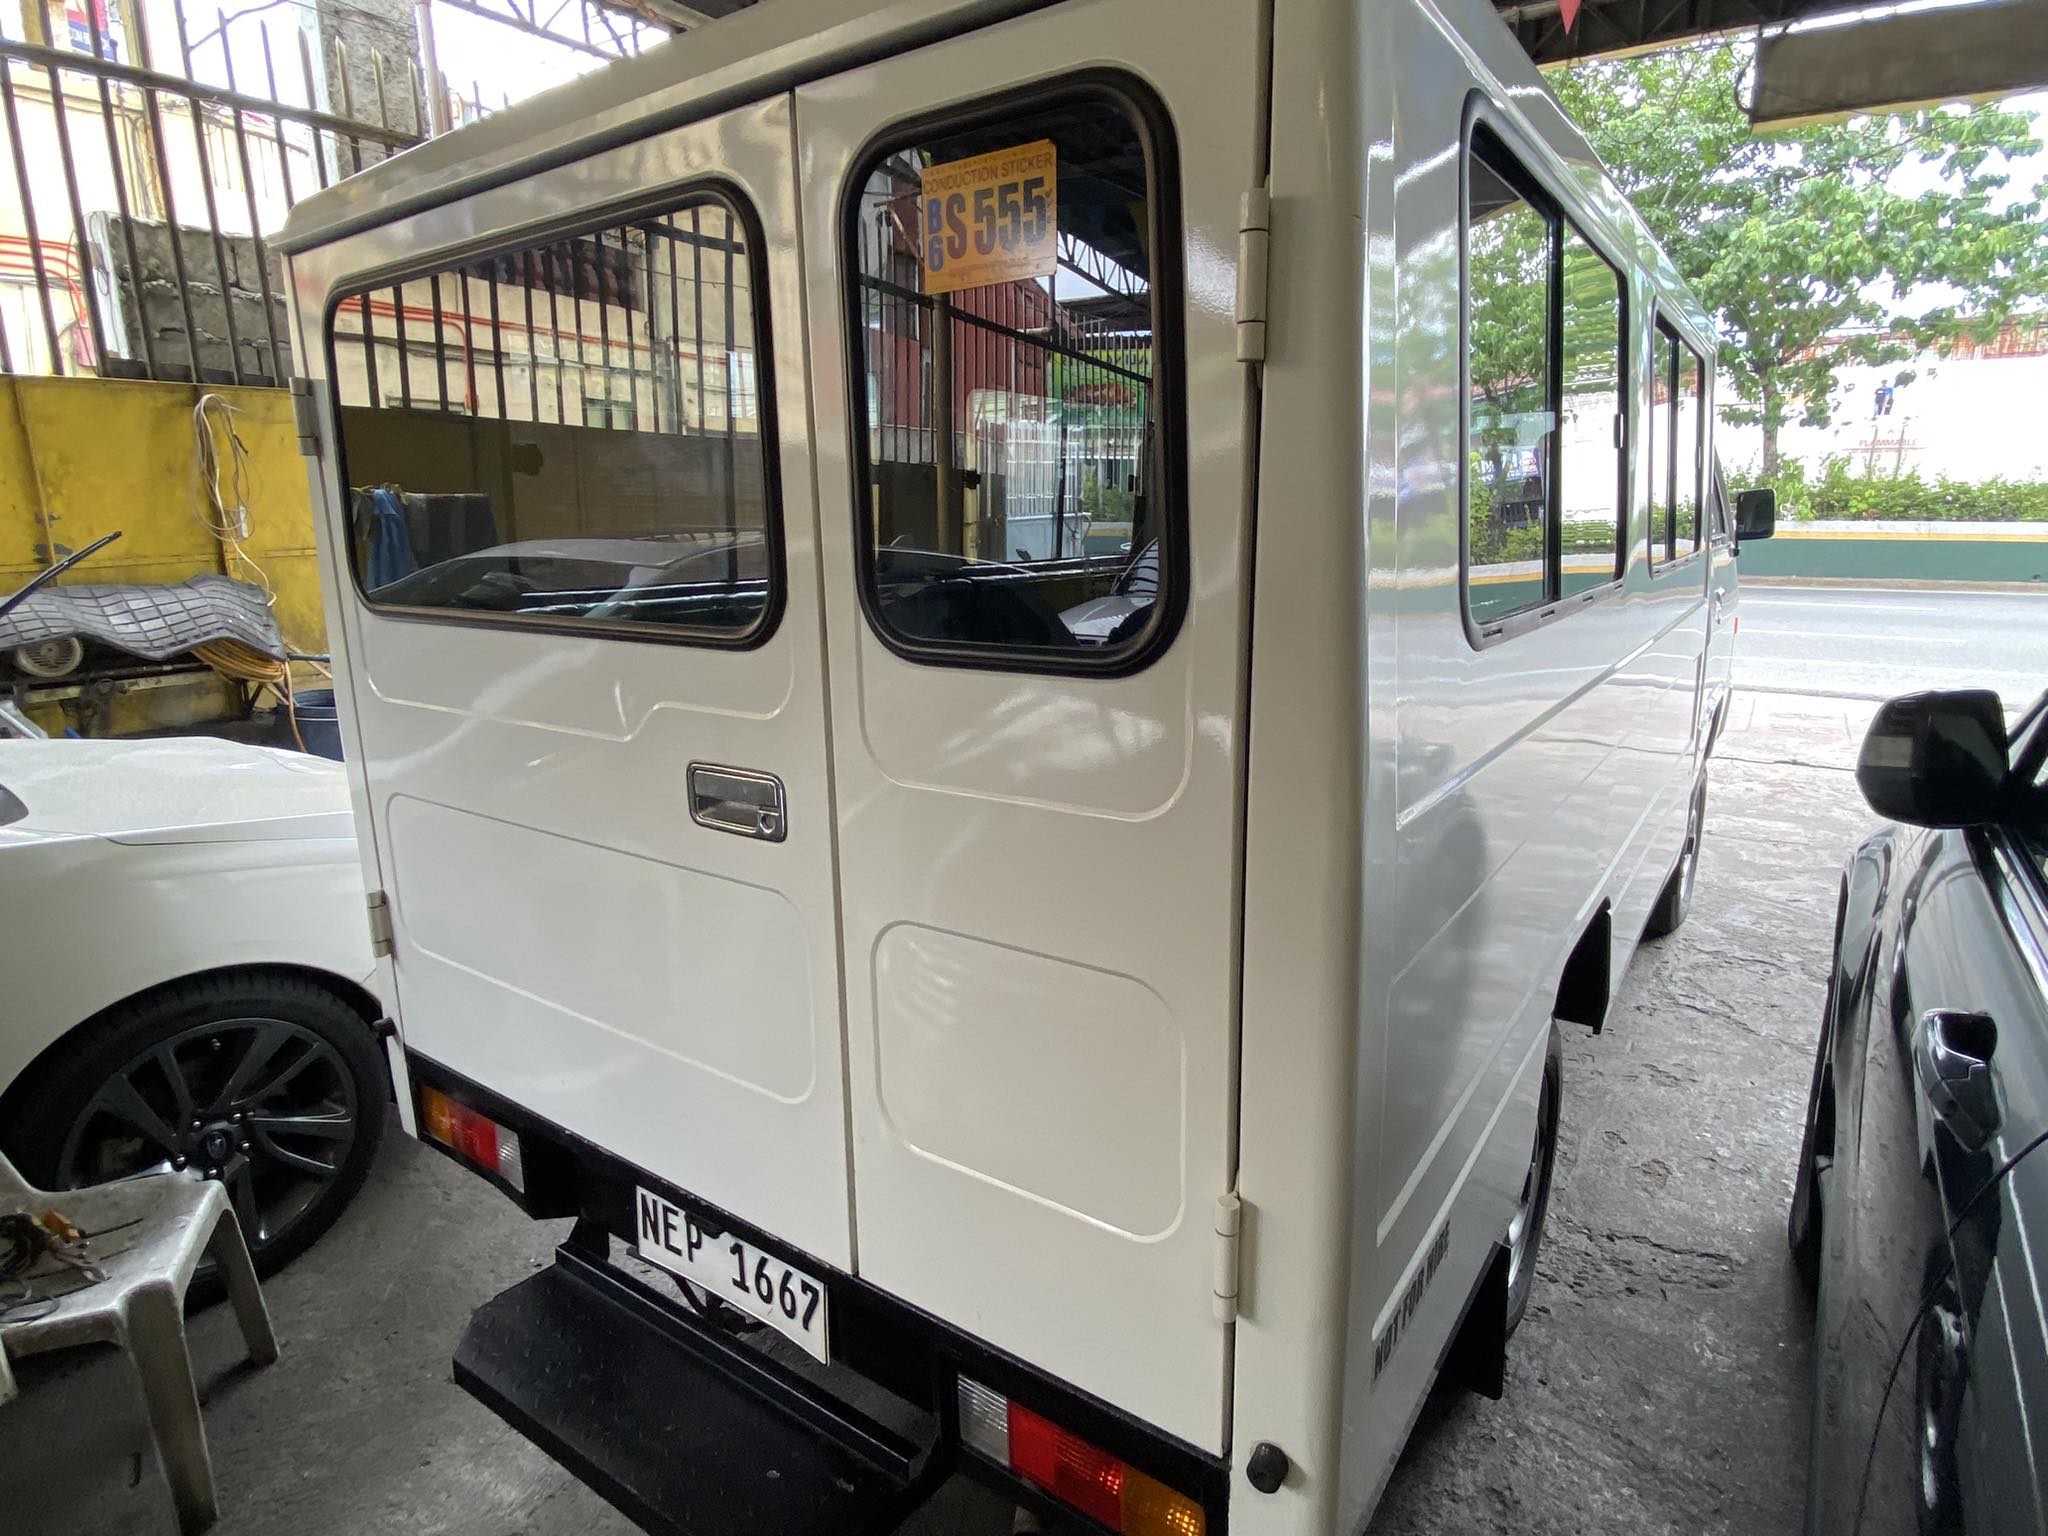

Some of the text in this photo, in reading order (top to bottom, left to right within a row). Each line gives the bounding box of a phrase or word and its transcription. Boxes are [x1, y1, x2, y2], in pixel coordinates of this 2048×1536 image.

[924, 166, 998, 195] CONDUCTION
[1002, 153, 1053, 176] STICKER
[640, 1193, 819, 1332] NEP 1667
[1374, 1309, 1401, 1382] NOT
[1402, 1267, 1424, 1331] FOR
